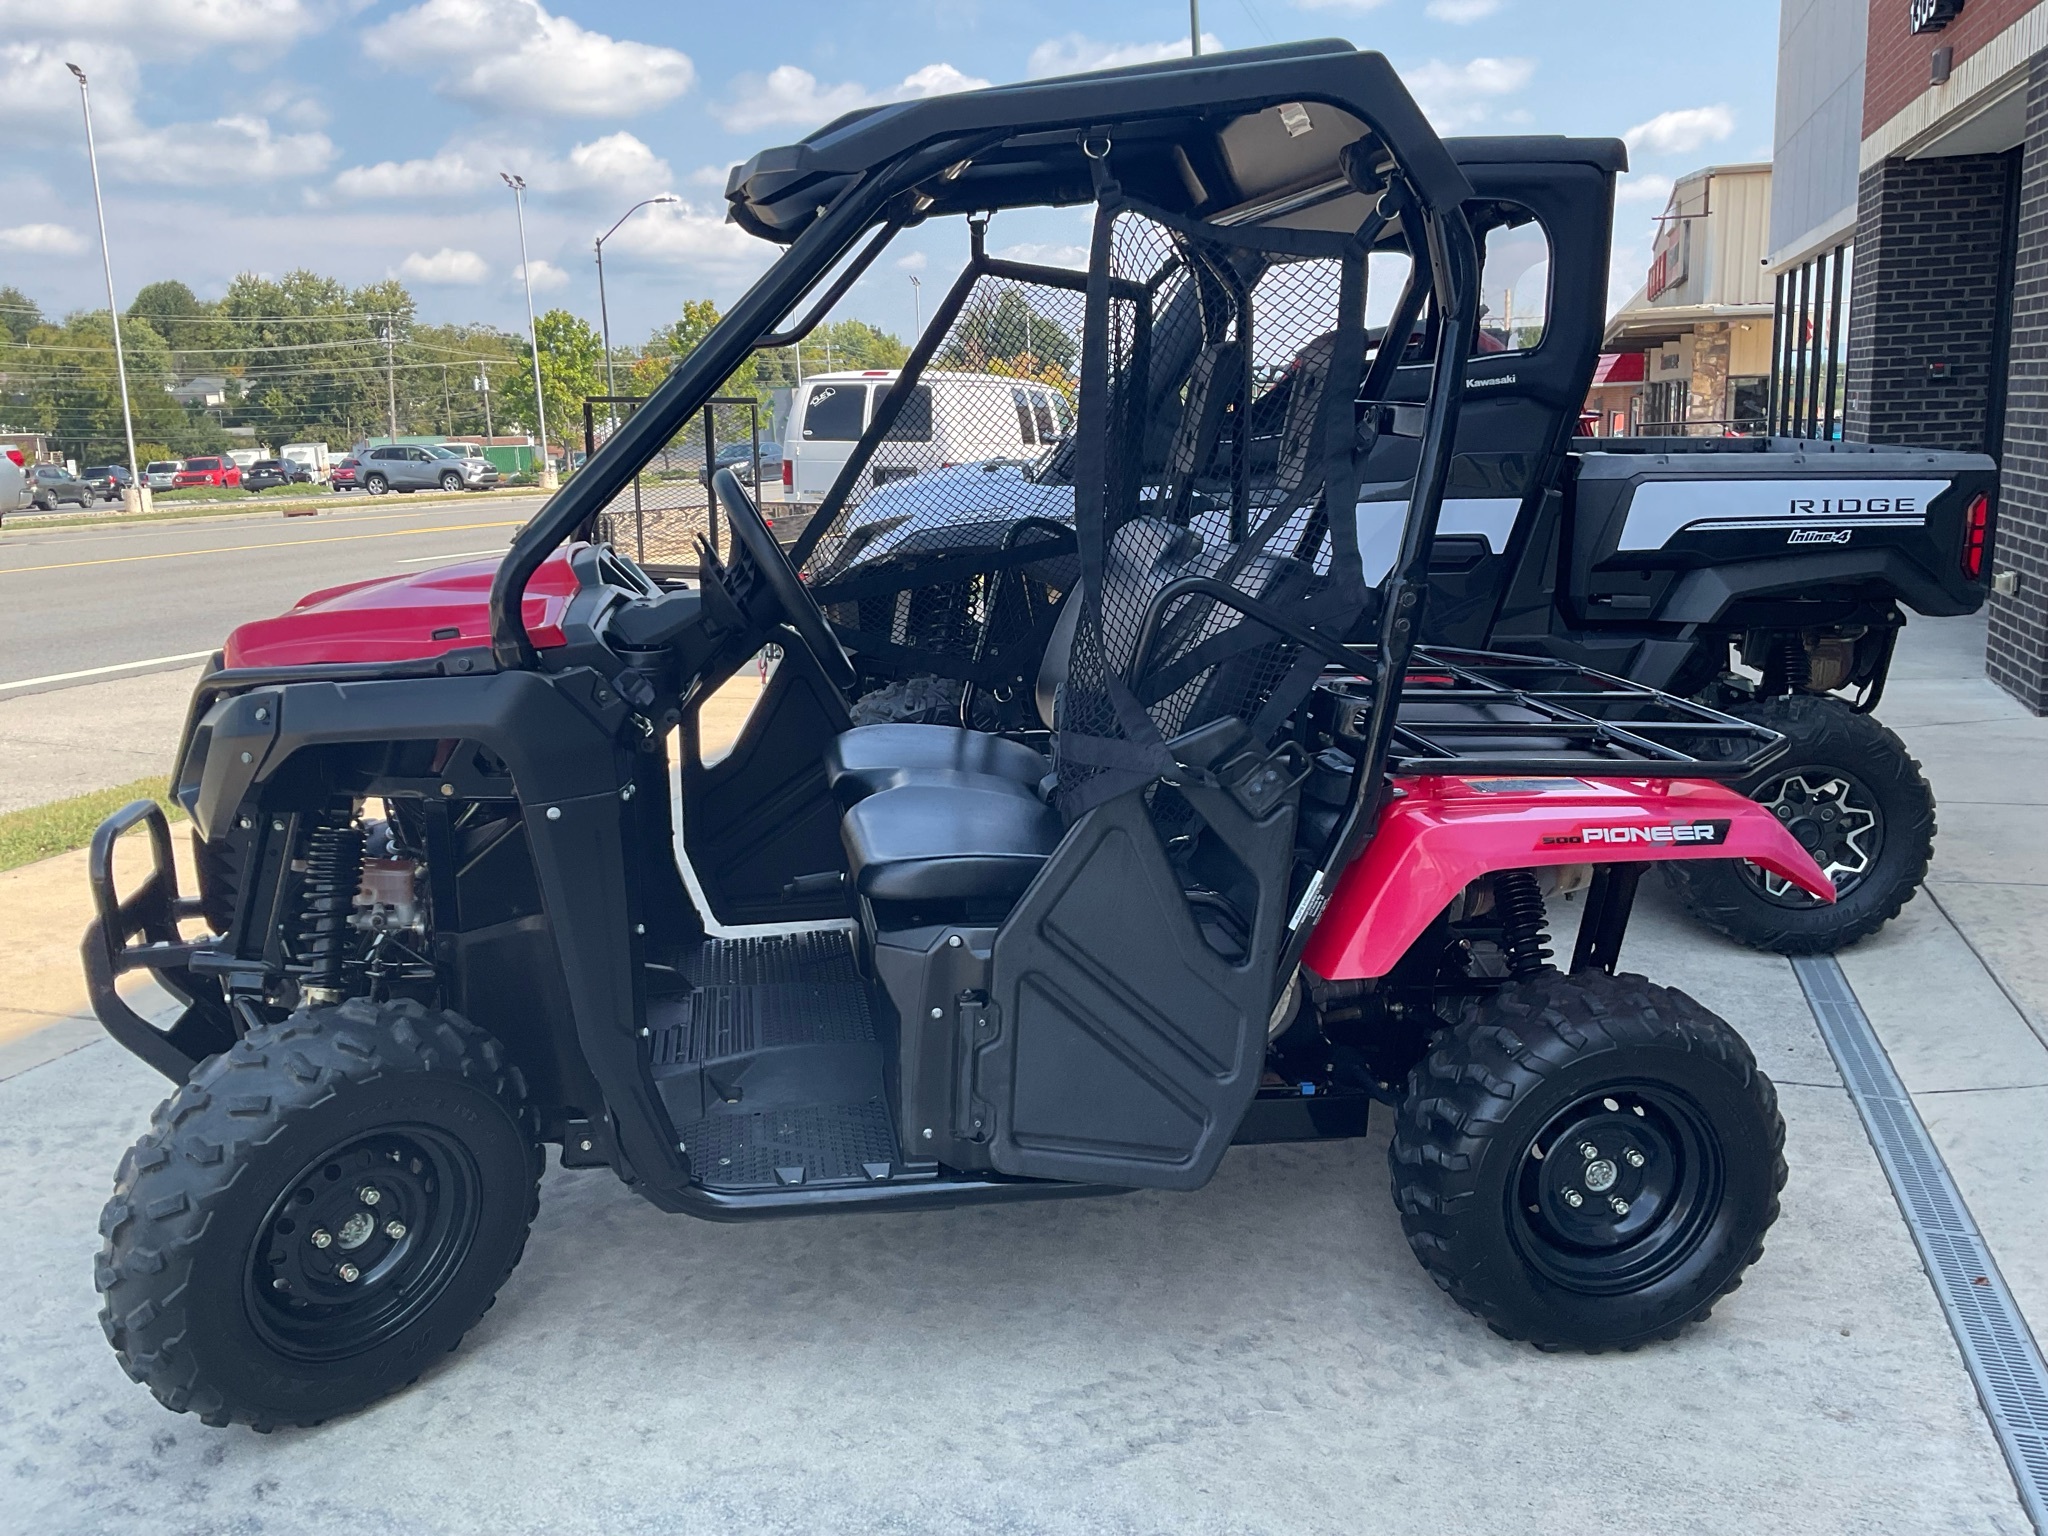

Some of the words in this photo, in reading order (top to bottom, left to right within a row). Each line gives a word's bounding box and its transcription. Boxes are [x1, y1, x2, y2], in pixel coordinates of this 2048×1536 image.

[1465, 374, 1516, 388] Kawasaki
[1790, 498, 1915, 514] RIDGE
[1787, 529, 1852, 544] Inline-4
[1542, 836, 1582, 844] 500
[1582, 825, 1715, 843] PIONEER
